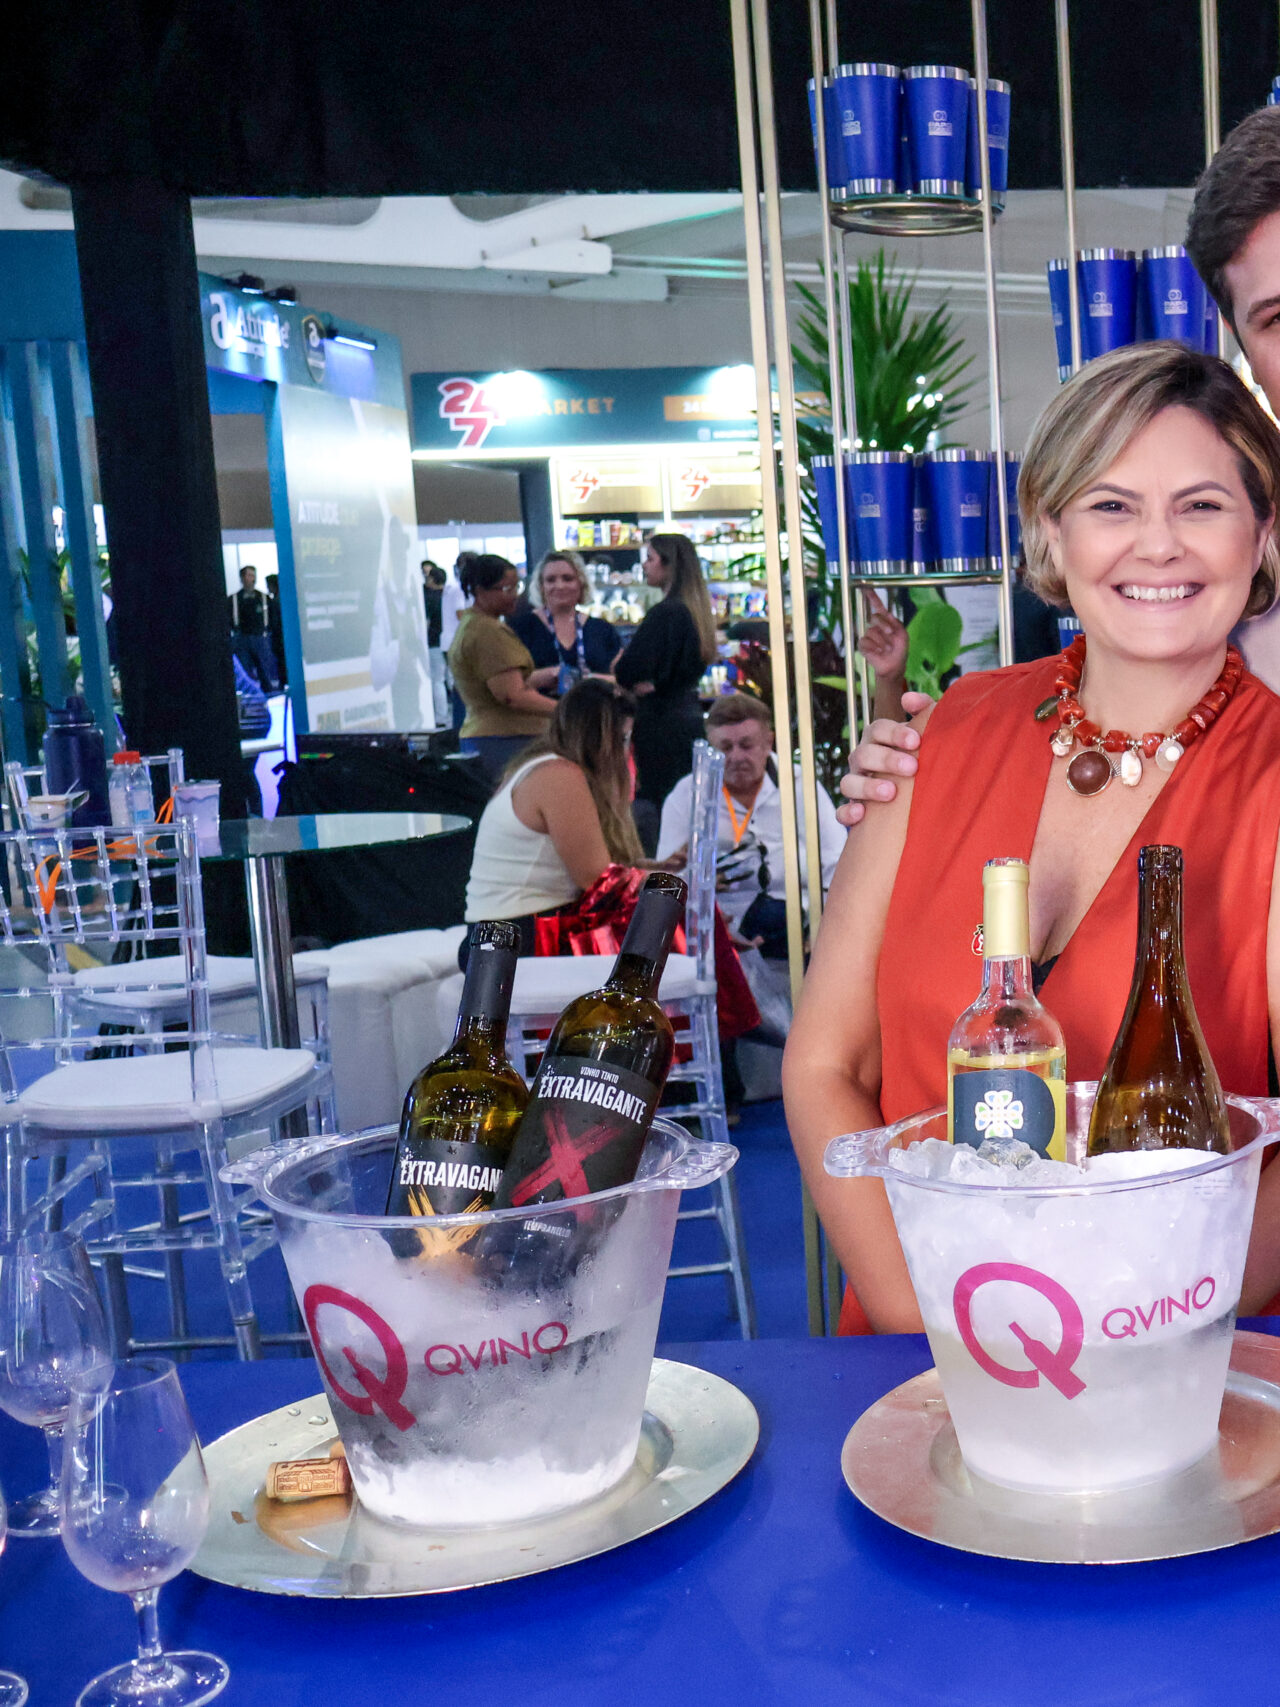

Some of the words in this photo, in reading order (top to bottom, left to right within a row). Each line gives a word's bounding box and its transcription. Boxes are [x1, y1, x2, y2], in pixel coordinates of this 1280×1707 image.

[537, 1074, 648, 1125] EXTRAVAGANTE
[400, 1159, 503, 1193] EXTRAVAGAN
[1101, 1276, 1216, 1340] QVINO
[423, 1321, 569, 1377] QVINO
